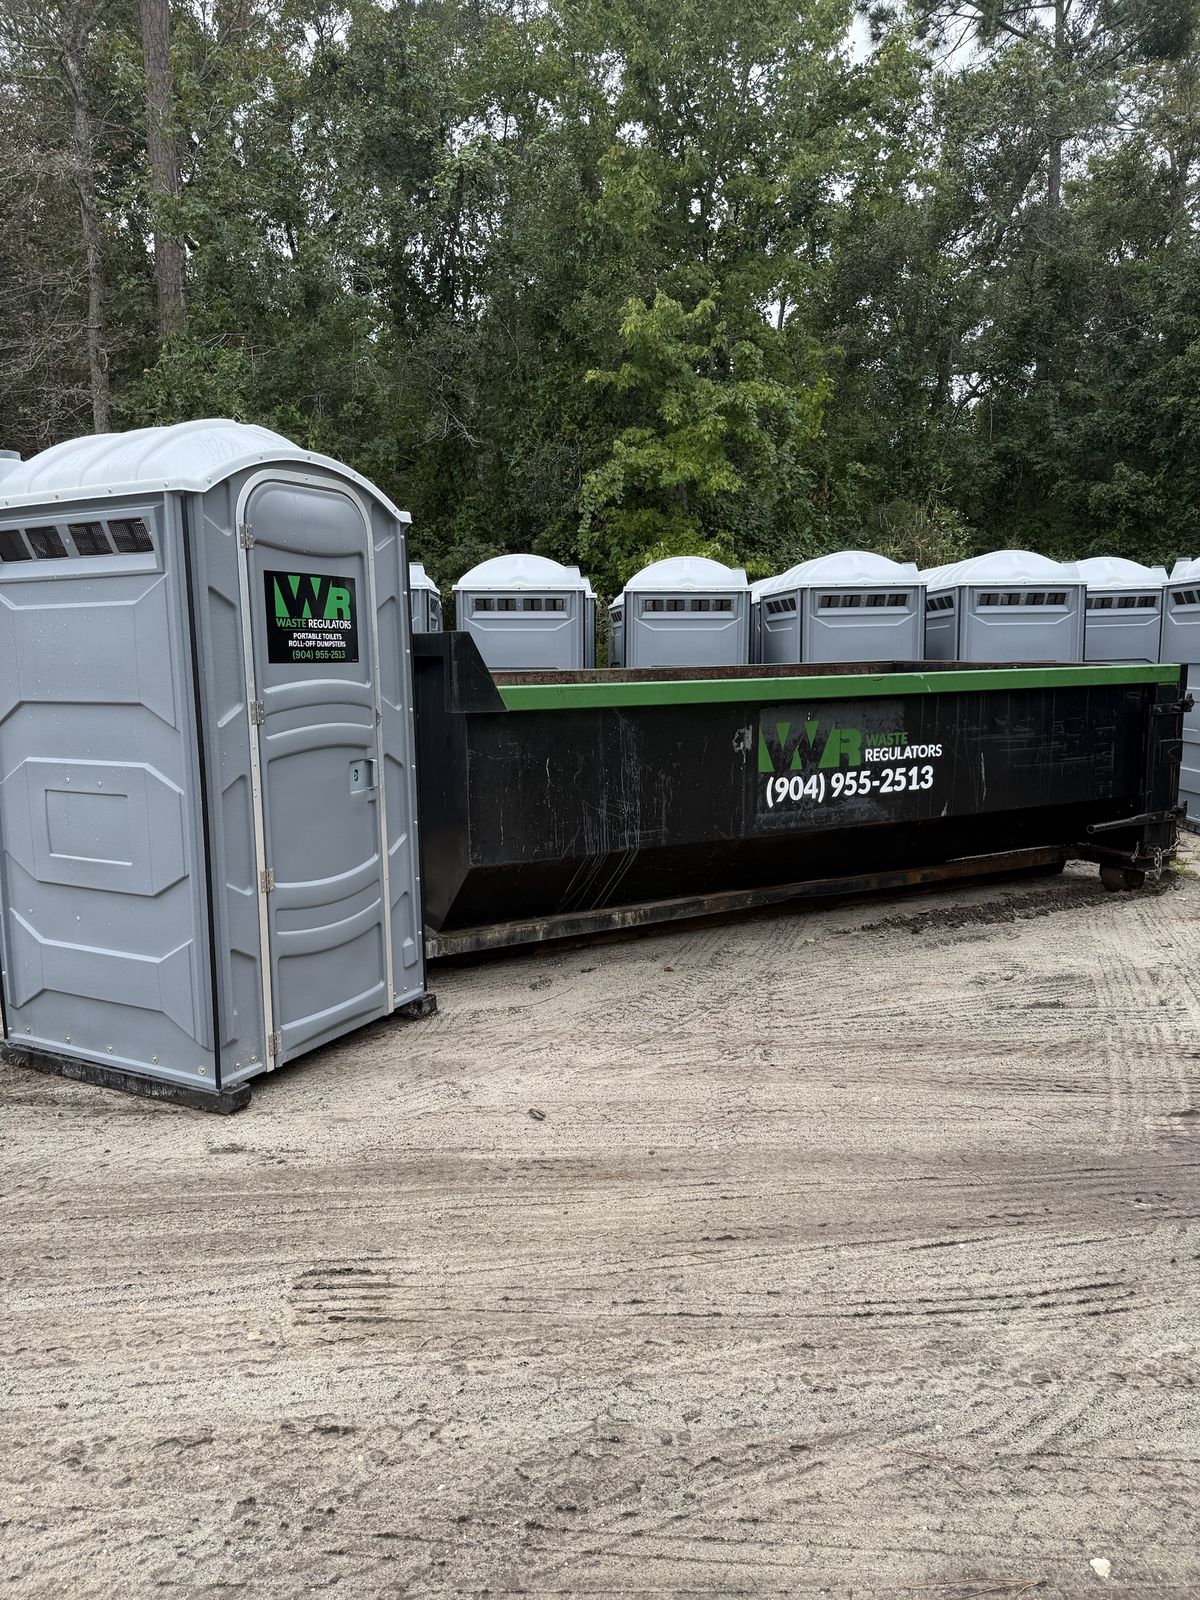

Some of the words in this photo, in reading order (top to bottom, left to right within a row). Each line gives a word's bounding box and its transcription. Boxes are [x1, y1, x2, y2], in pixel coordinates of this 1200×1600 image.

[276, 618, 306, 628] WASTE
[308, 619, 352, 629] REGULATORS
[292, 650, 314, 660] (904)
[315, 650, 346, 659] 955-2513
[866, 731, 908, 746] WASTE
[865, 744, 943, 762] REGULATORS
[766, 772, 826, 808] (904)
[830, 765, 934, 798] 955-2513
